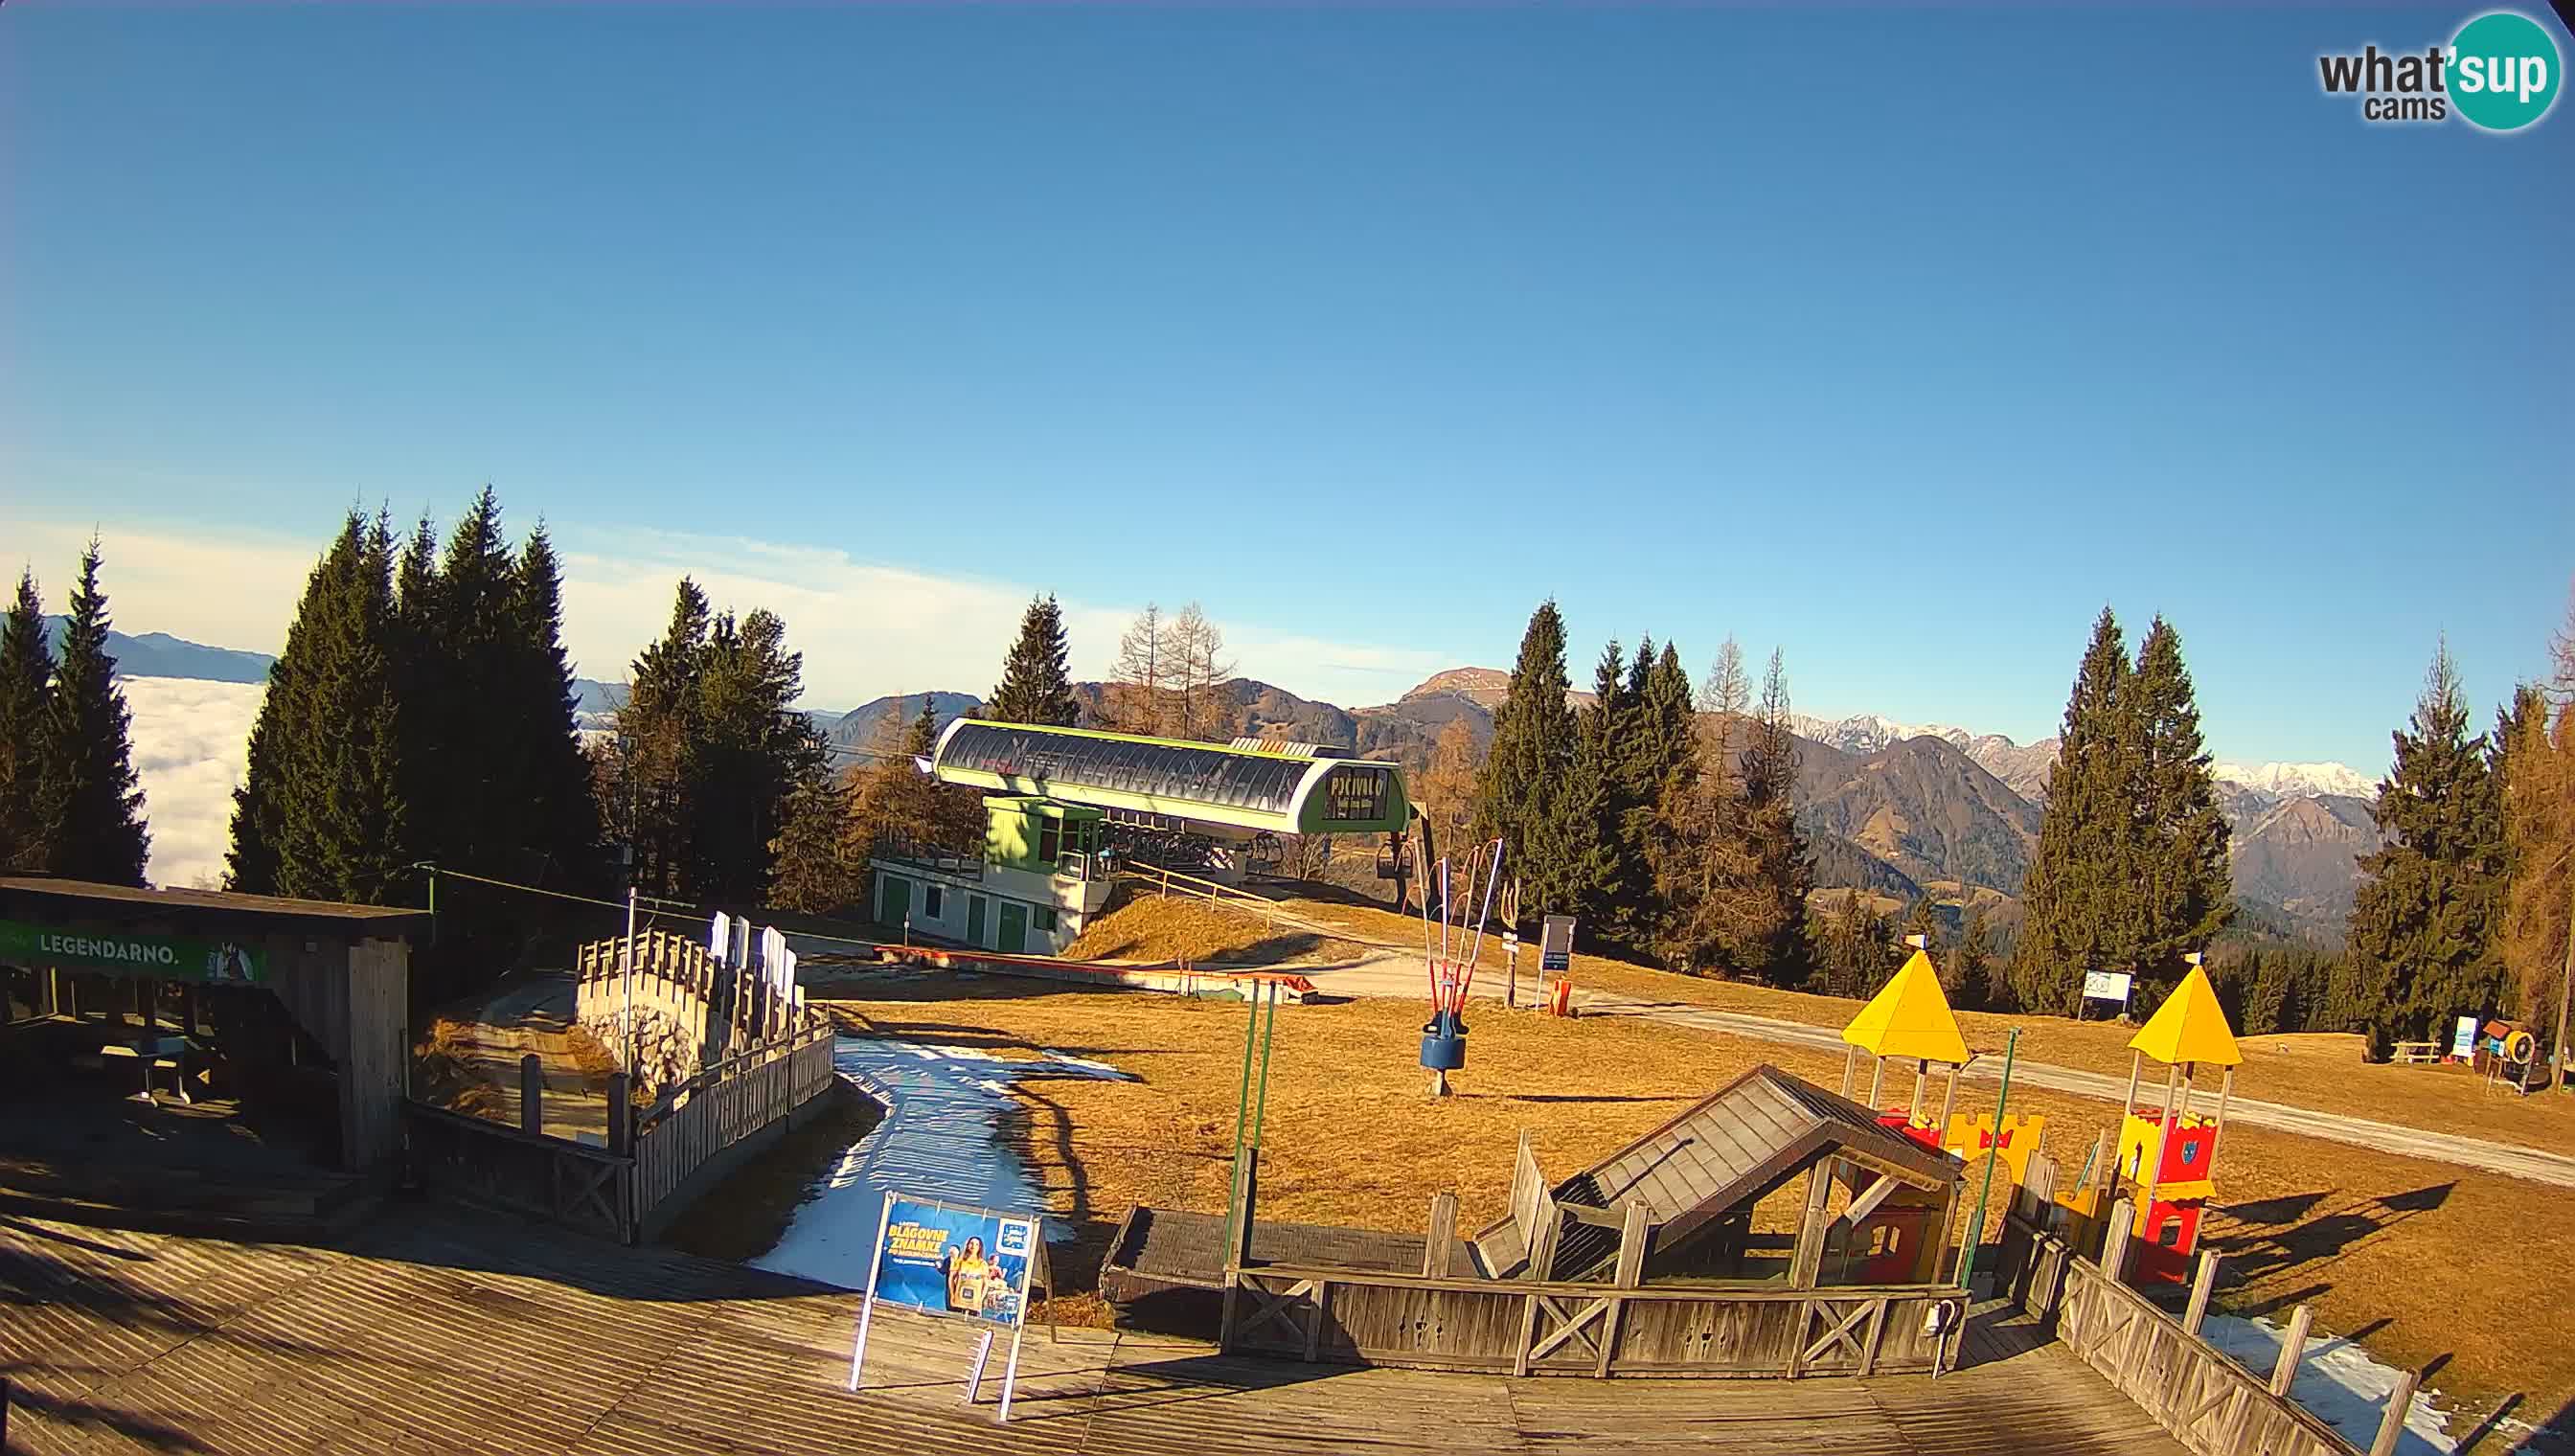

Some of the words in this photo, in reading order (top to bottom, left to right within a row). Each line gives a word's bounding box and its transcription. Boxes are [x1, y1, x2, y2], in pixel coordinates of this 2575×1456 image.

[39, 934, 179, 965] LEGENDARNO.
[888, 1224, 949, 1242] BLAGOVNE
[891, 1238, 942, 1253] ZNAMKE
